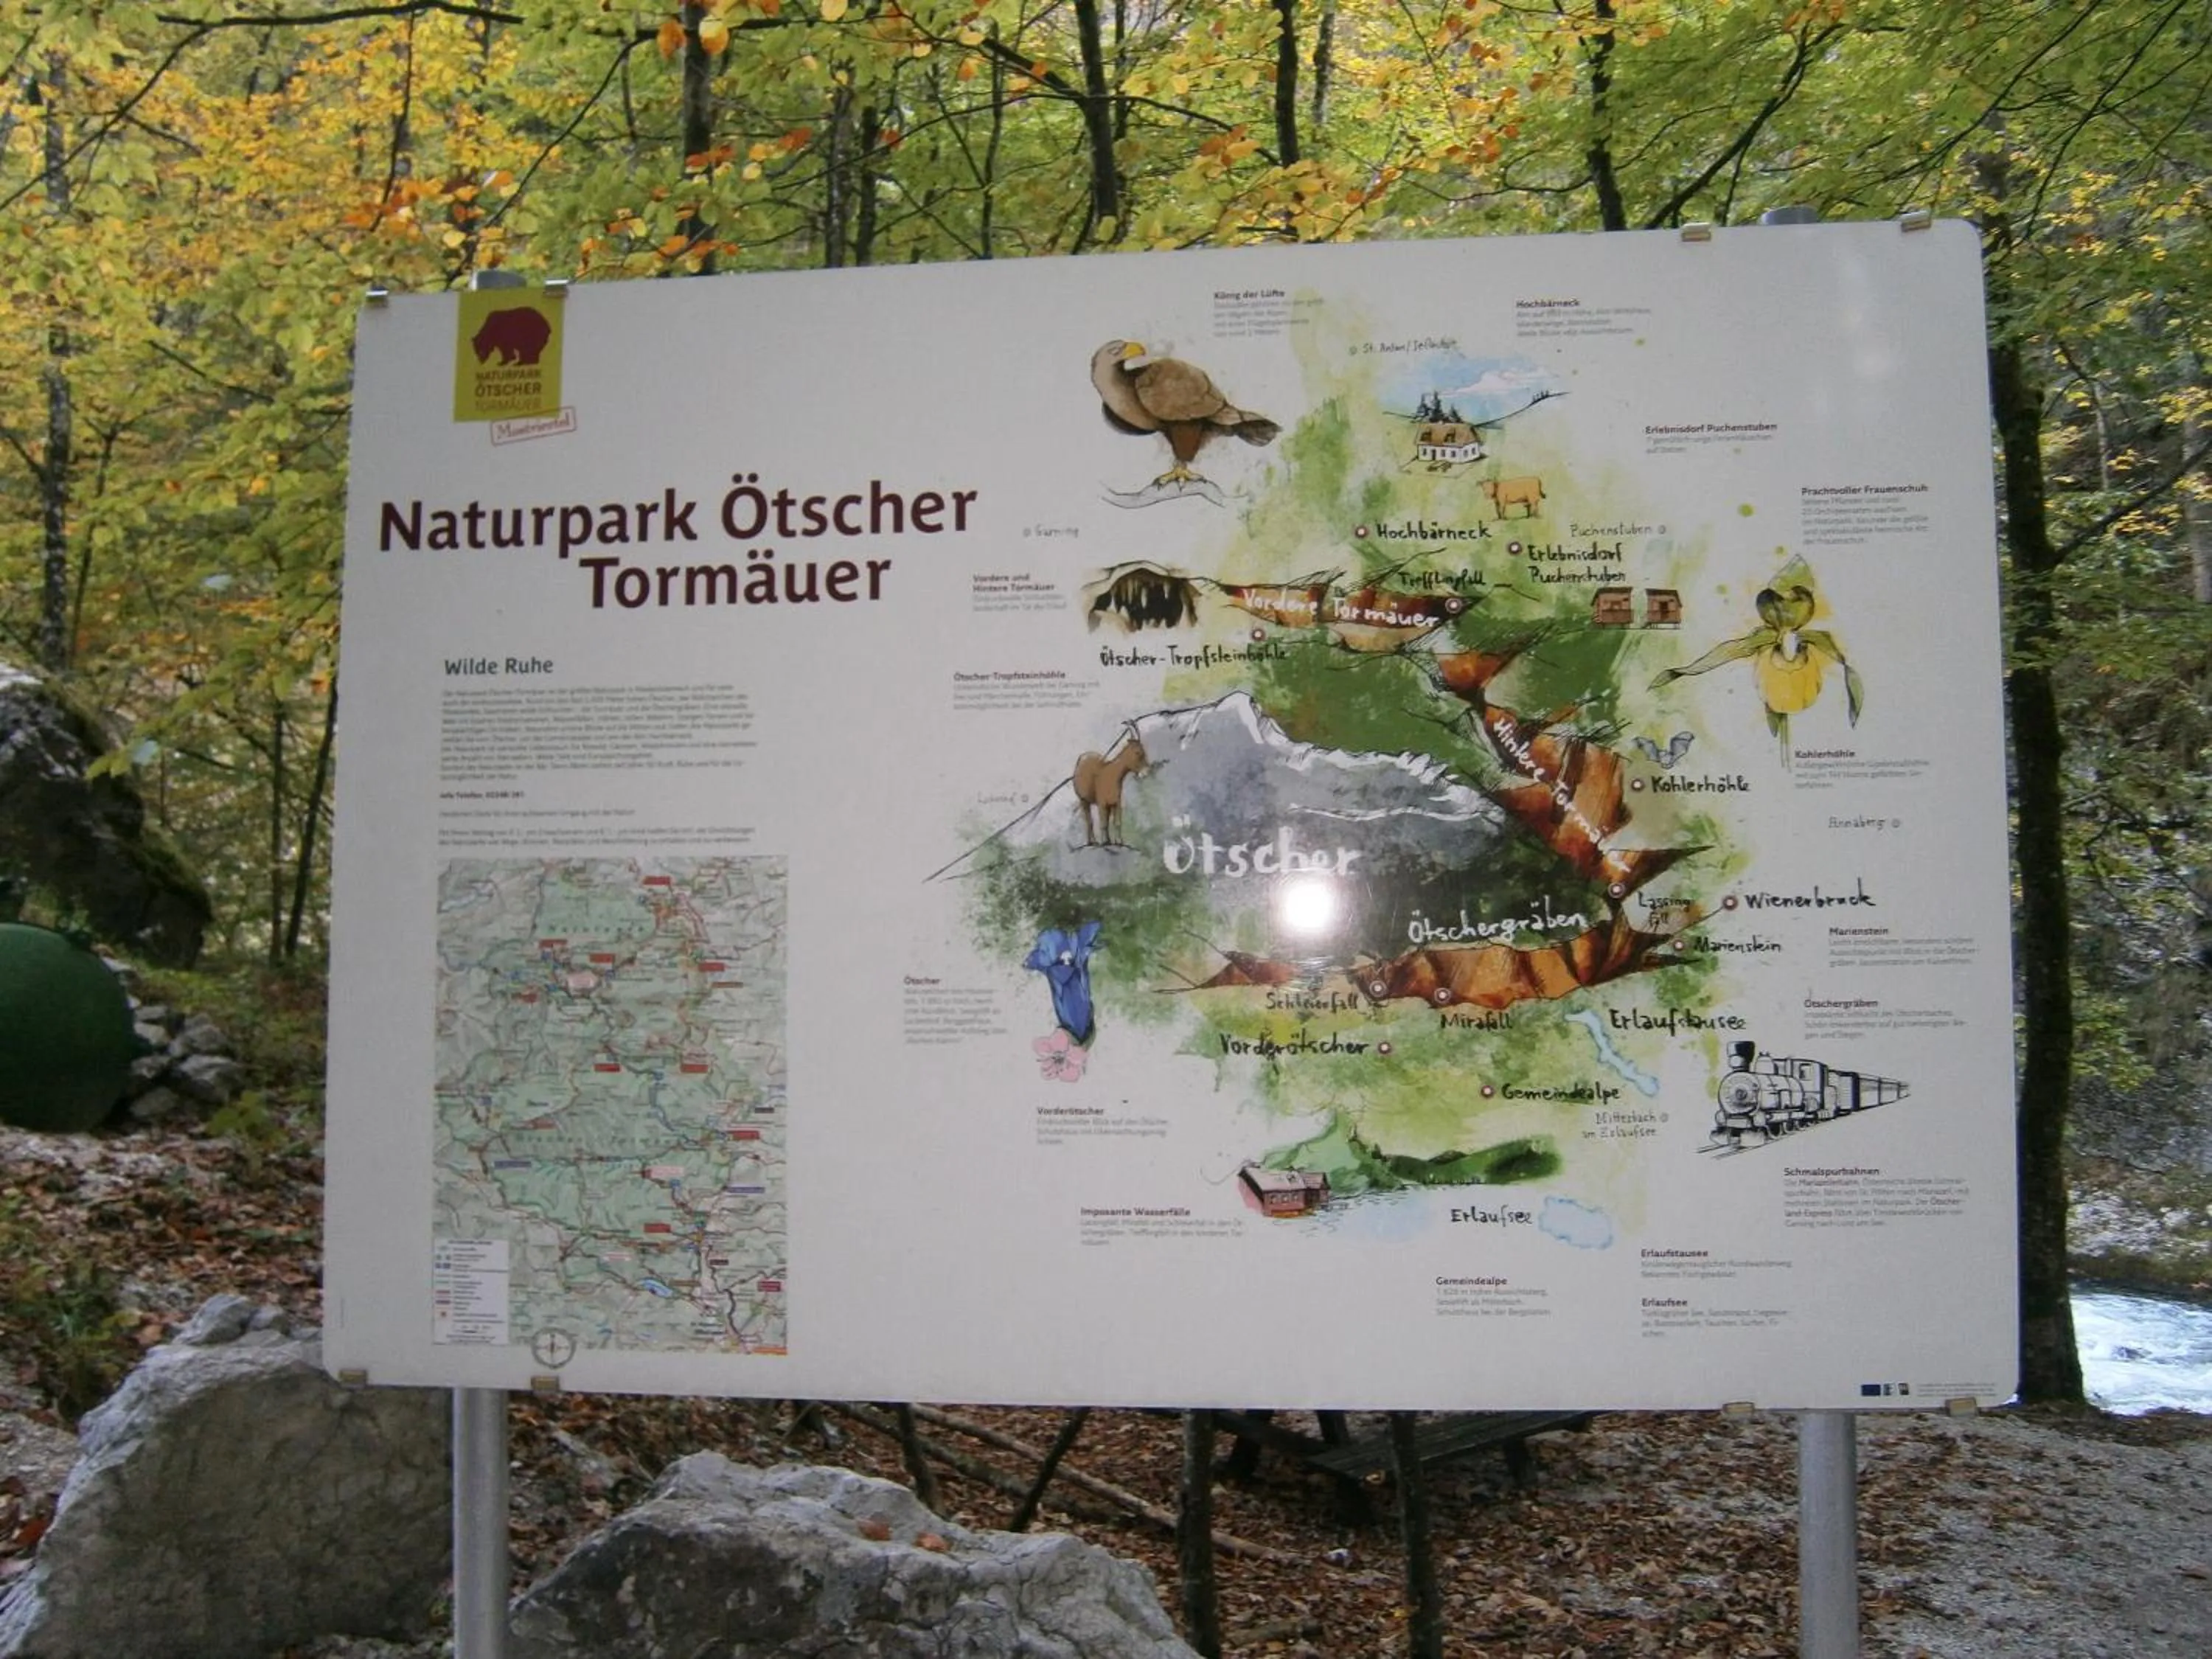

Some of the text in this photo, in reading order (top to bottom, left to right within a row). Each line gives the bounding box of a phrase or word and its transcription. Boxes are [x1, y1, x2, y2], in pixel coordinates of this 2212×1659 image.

[475, 381, 542, 397] ÖTSCHER
[1645, 422, 1778, 434] Erlebnisdorf Puchenstuben
[1864, 484, 1928, 494] Frauenschuh
[380, 473, 977, 558] Naturpark Ötscher
[1377, 520, 1492, 539] Hochbärneck
[1527, 541, 1622, 562] Erlebnisdorf
[580, 549, 891, 609] Tormäuer
[1528, 566, 1627, 583] Puchenstuben
[1332, 597, 1441, 627] Tormäuer
[444, 656, 554, 676] Wilde Ruhe
[1651, 774, 1750, 793] Kohlerhöhle
[1164, 815, 1363, 878] Ötscher
[1744, 877, 1877, 909] Wienerbruck
[1408, 895, 1589, 943] Ötschergräben
[1829, 927, 1889, 936] Marienstein
[1694, 935, 1781, 953] Marienstein
[1440, 1010, 1513, 1032] Mirafall
[1609, 1007, 1747, 1037] Erlaufstausee
[1220, 1028, 1371, 1056] Vorderötscher
[1501, 1081, 1621, 1105] Gemeindealpe
[1451, 1203, 1533, 1228] Erlaufsee
[1436, 1276, 1508, 1287] Gemeindealpe
[1642, 1298, 1688, 1307] Erlaufsee
